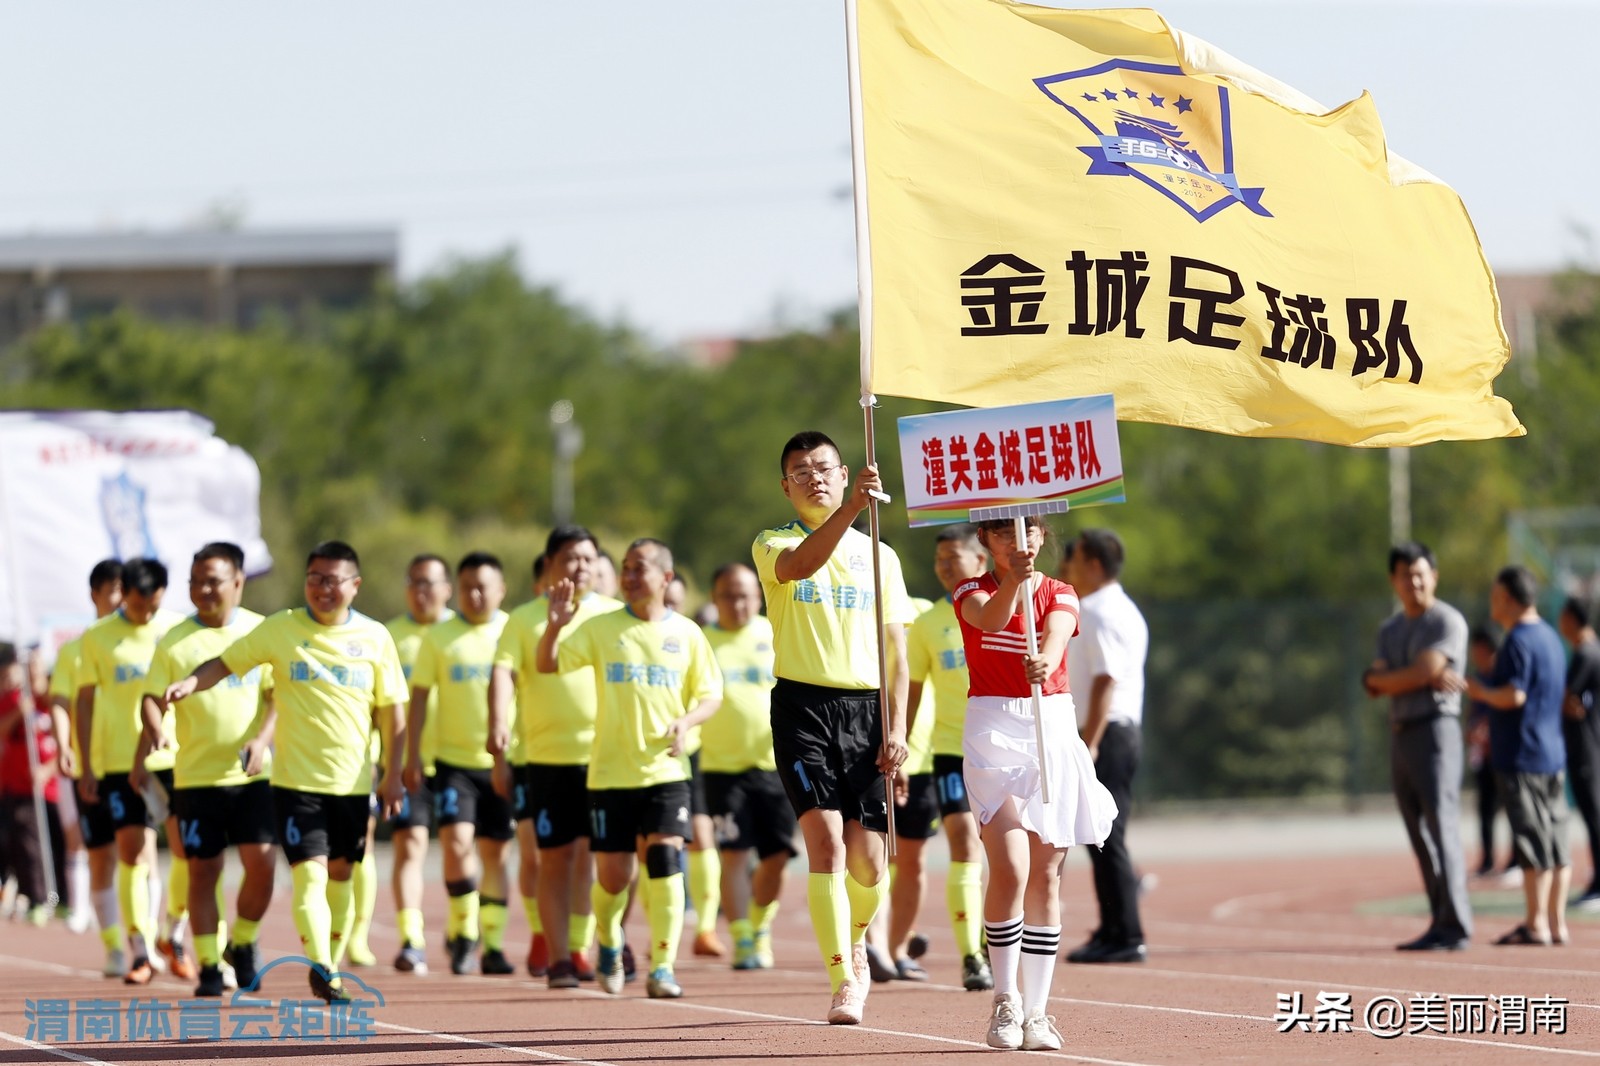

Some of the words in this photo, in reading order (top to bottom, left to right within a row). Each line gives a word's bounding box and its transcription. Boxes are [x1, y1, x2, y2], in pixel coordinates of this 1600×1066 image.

[959, 250, 1424, 385] 金城足球队
[921, 419, 1102, 496] 潼关金城足球队
[794, 760, 811, 792] 1
[286, 816, 301, 845] 6
[537, 808, 552, 837] 6
